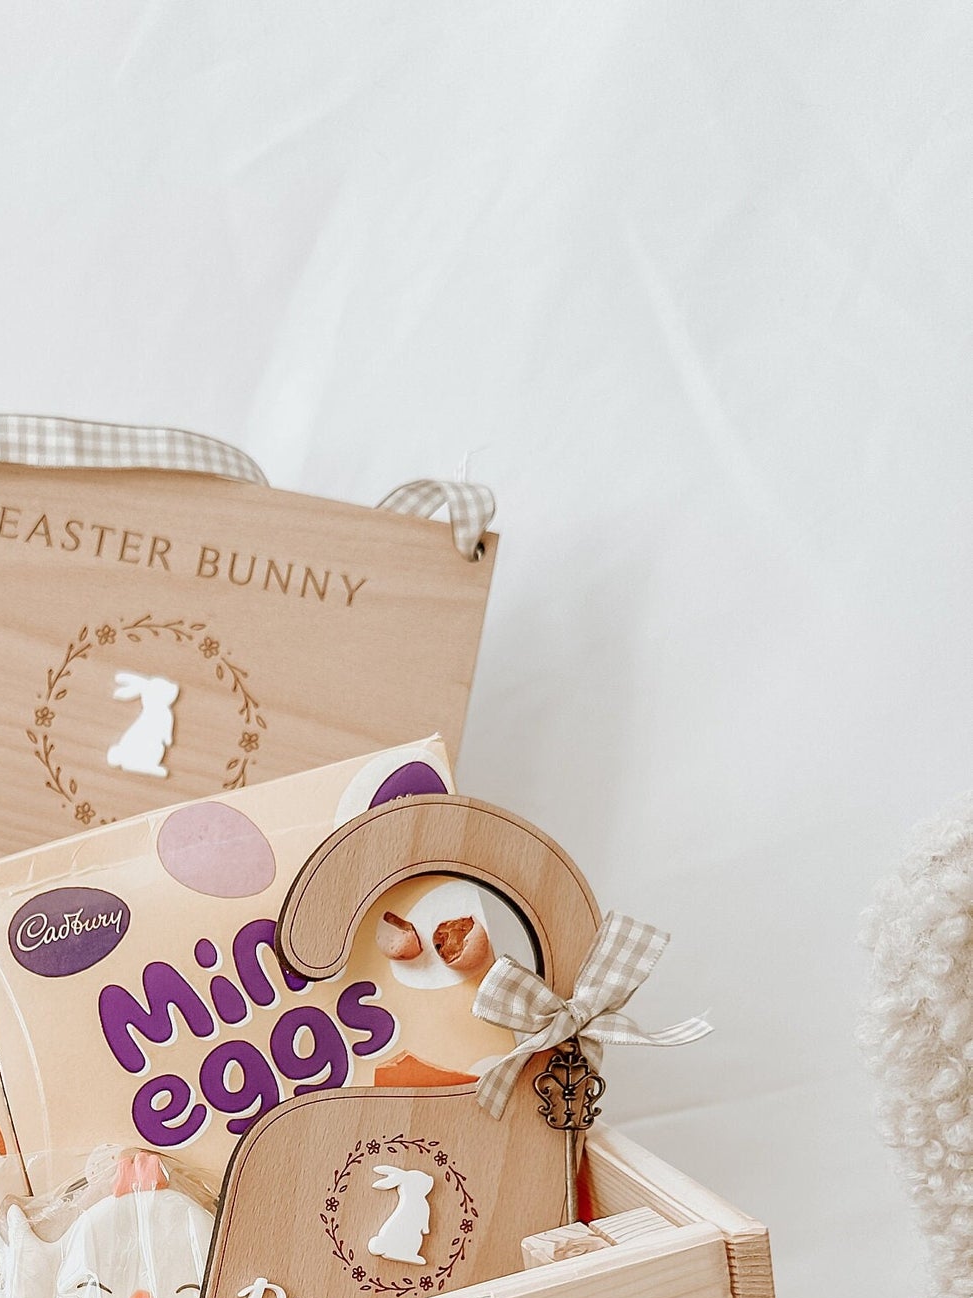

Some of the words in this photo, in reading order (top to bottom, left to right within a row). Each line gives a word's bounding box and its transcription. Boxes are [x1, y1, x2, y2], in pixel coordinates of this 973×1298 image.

[195, 545, 368, 607] BUNNY
[16, 907, 123, 952] Cadbury
[98, 919, 311, 1075] Min
[132, 981, 396, 1147] eggs
